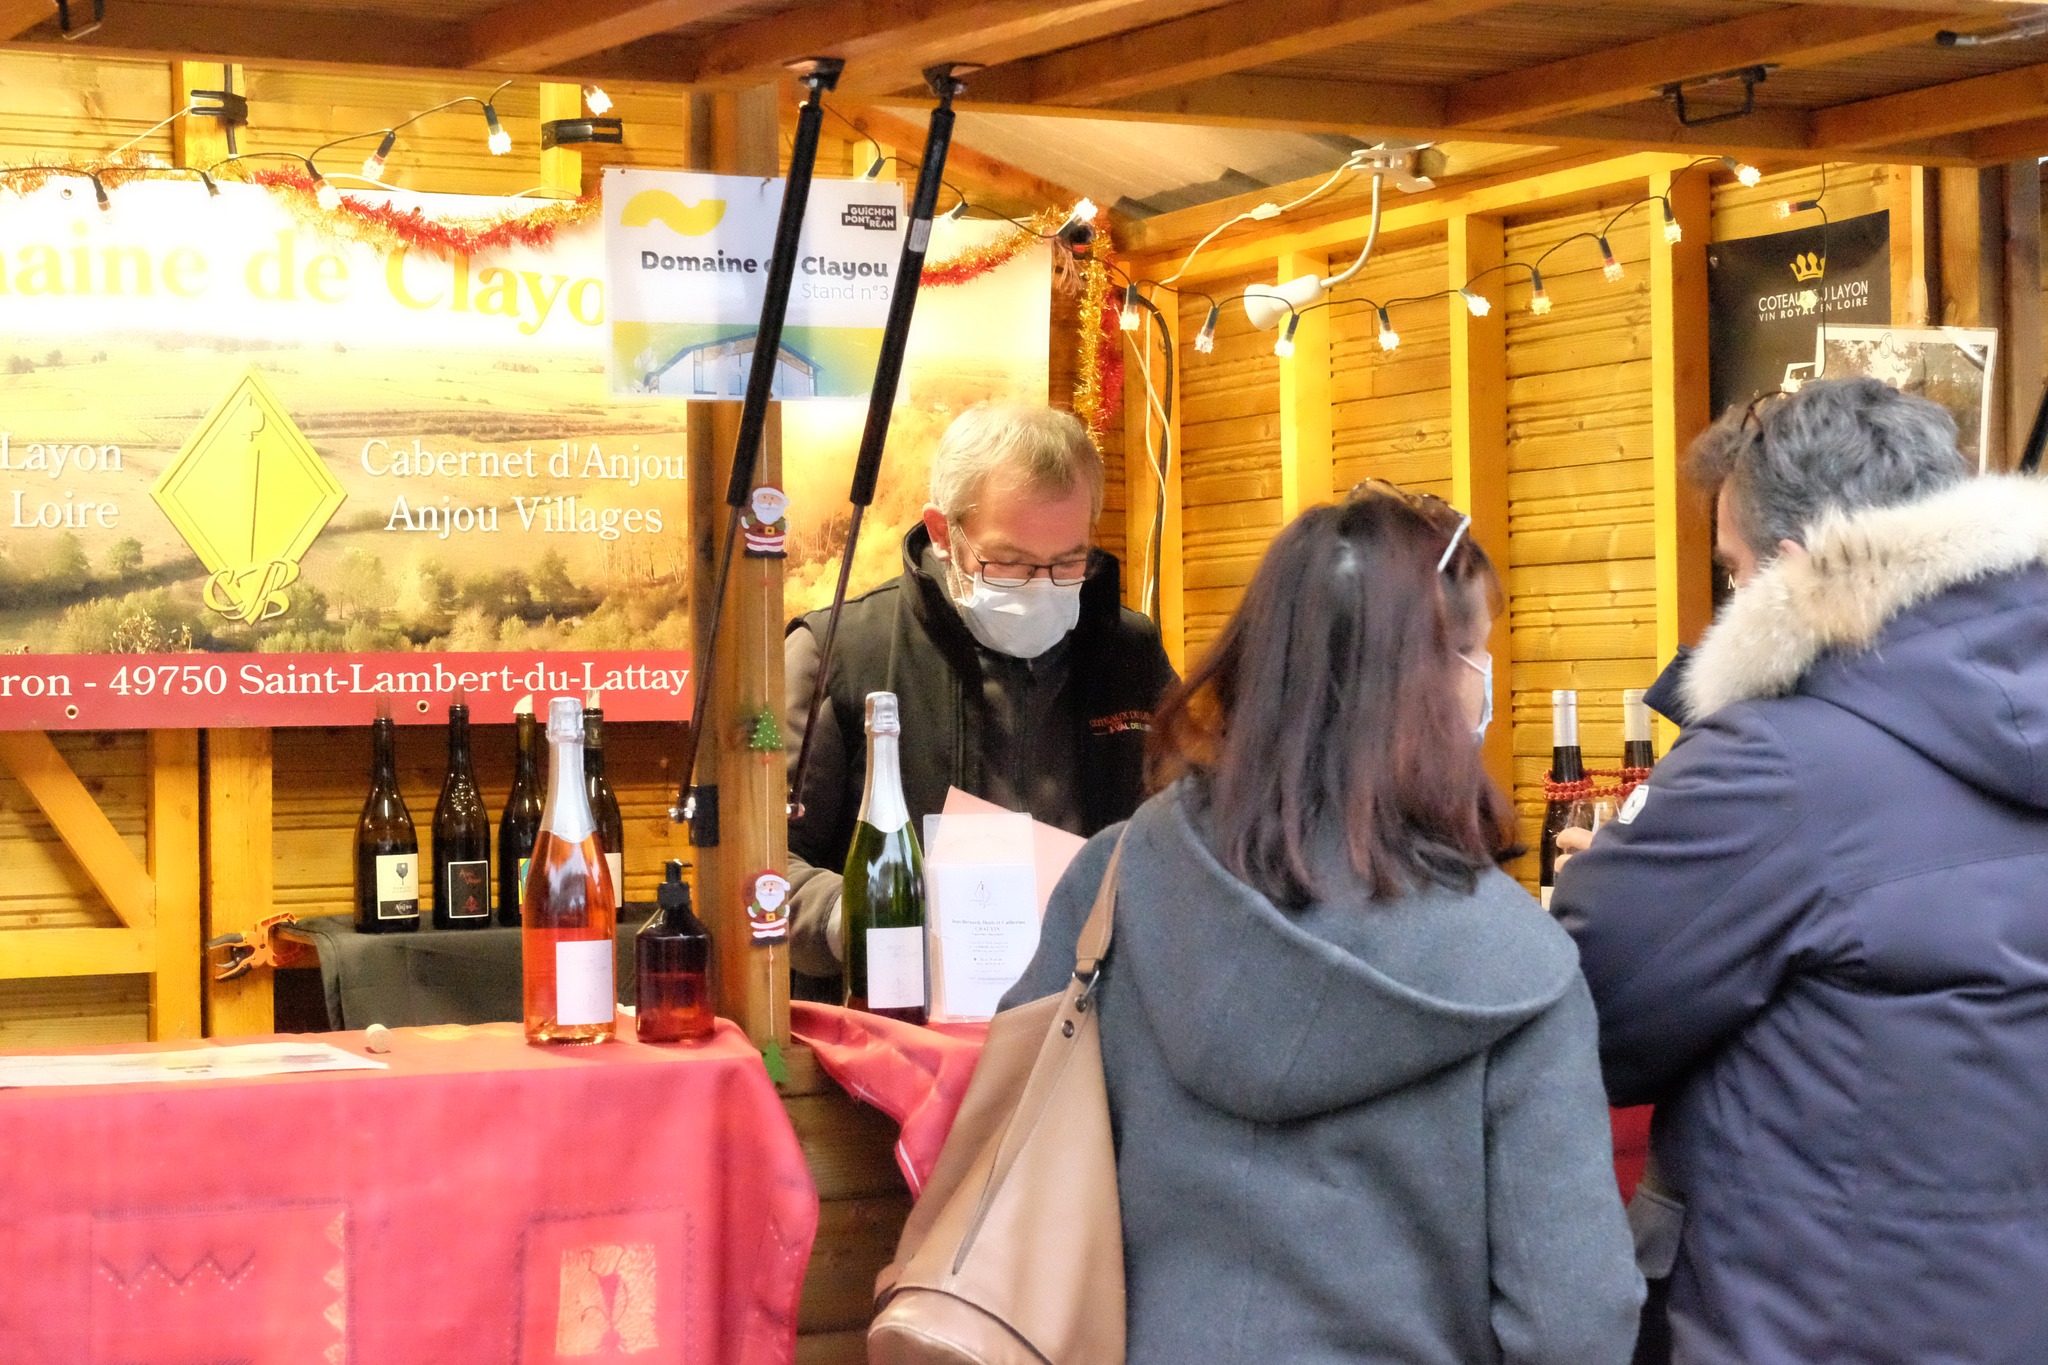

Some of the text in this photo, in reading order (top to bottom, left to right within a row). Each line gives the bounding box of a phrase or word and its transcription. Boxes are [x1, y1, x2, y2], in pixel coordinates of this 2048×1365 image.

[844, 215, 871, 224] PONT
[244, 228, 348, 303] de
[641, 249, 758, 274] Domaine
[801, 256, 889, 281] Clayou
[801, 283, 890, 300] Stand n°3
[1758, 291, 1805, 312] COTEAU
[1831, 280, 1869, 300] LAYON
[1758, 296, 1868, 321] VIN ROYAL EN LOIRE
[0, 431, 123, 478] Layon
[361, 439, 687, 487] Cabernet d'Anjou
[10, 490, 120, 529] Loire
[384, 495, 663, 541] Anjou Villages
[109, 665, 227, 696] 49750
[239, 661, 690, 696] Saint-Lambert-du-Lattay
